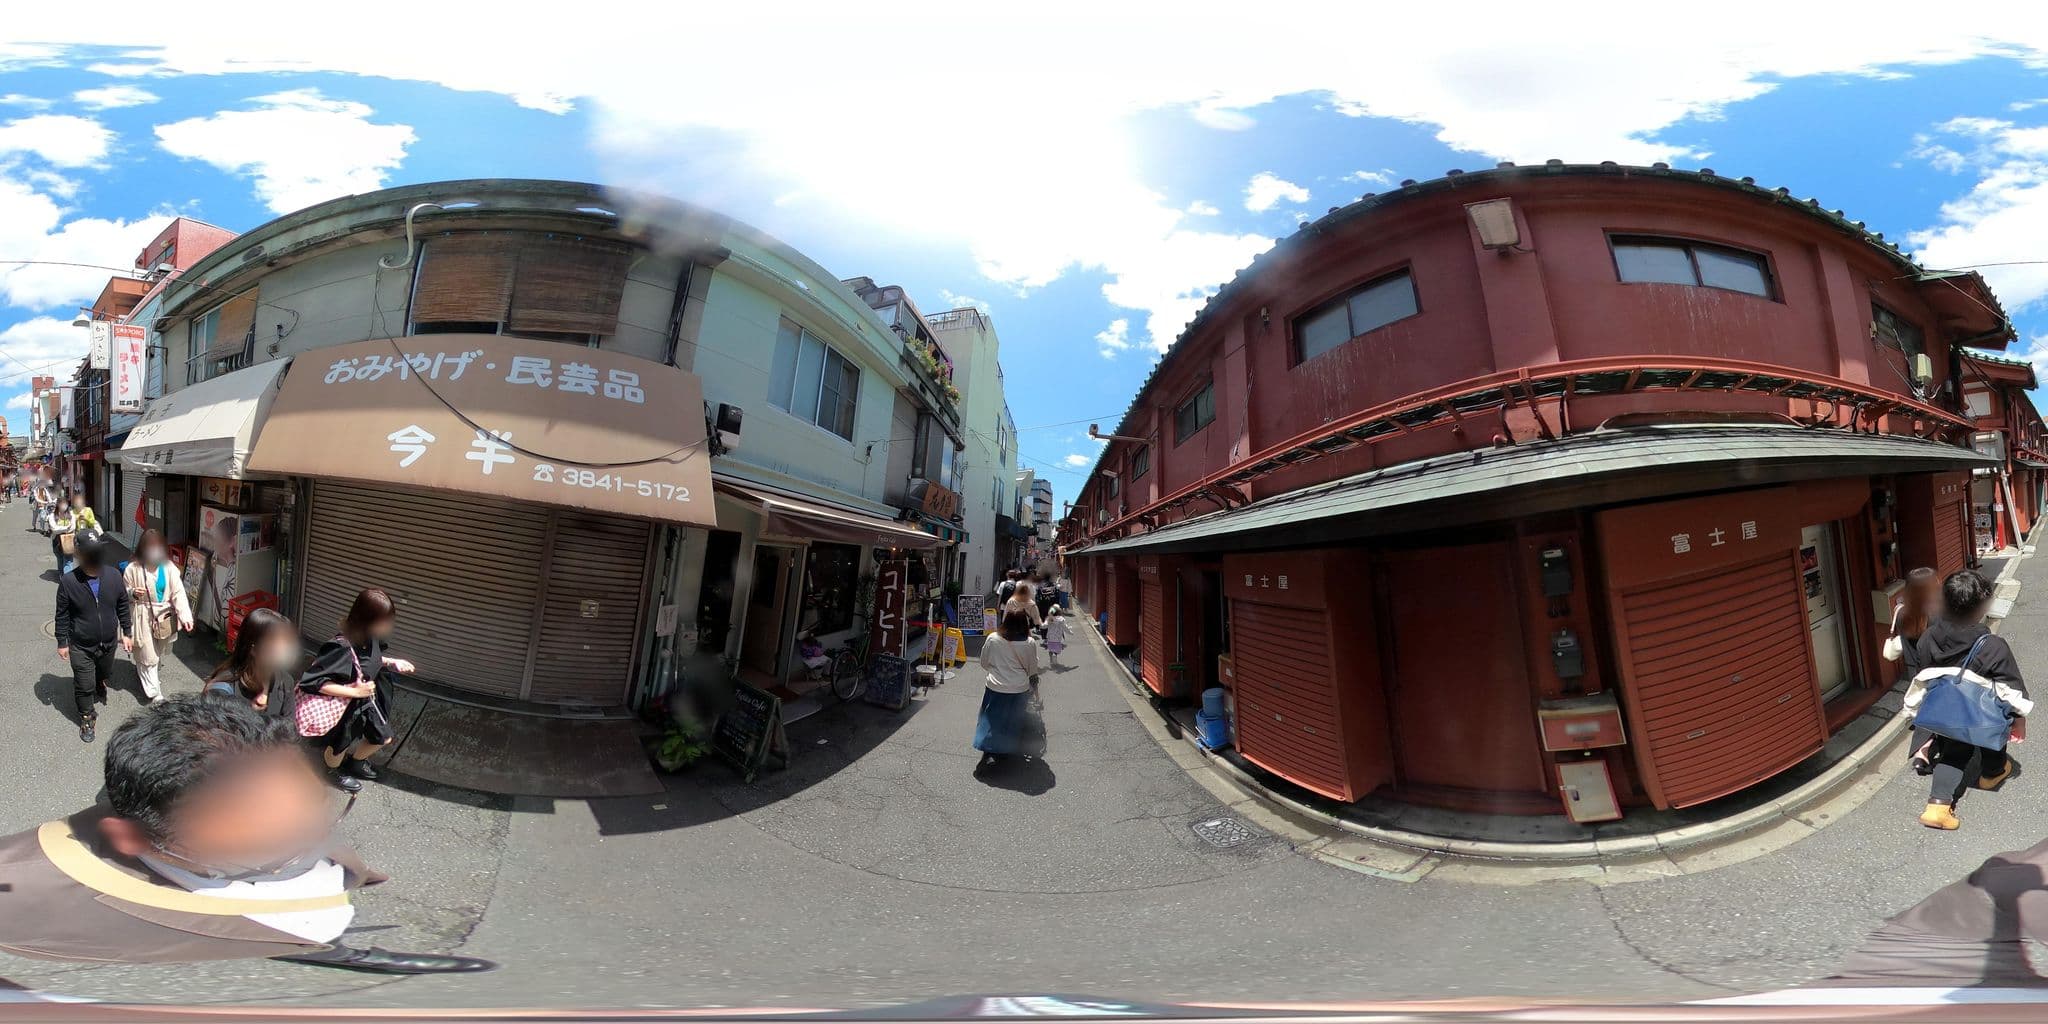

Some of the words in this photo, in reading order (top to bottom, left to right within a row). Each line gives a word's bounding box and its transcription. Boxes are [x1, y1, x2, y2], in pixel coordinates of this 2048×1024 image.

[119, 353, 129, 395] ラーメン
[324, 349, 646, 404] おみやげ・民芸品
[387, 424, 515, 474] 今半
[561, 469, 690, 502] 3841-5172
[1671, 520, 1758, 554] 富士屋
[1245, 574, 1289, 590] 富士屋
[879, 571, 898, 647] コーヒー
